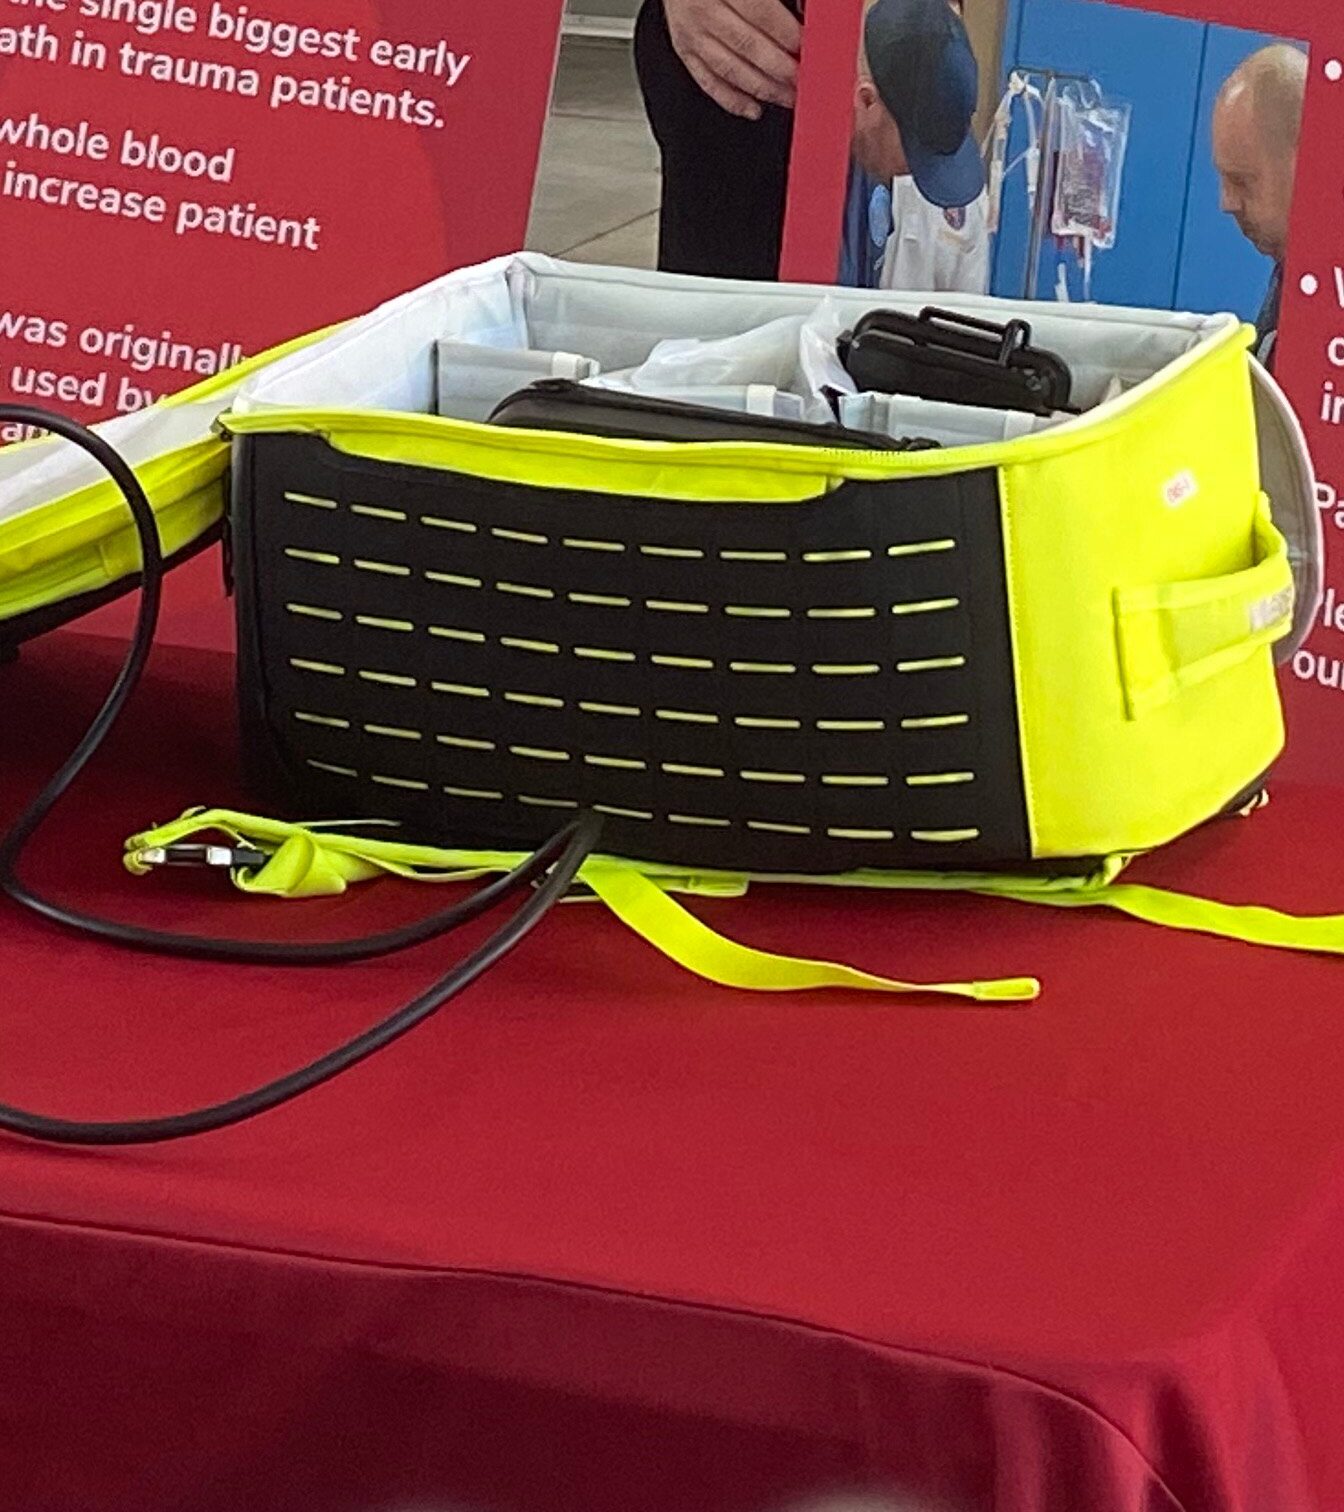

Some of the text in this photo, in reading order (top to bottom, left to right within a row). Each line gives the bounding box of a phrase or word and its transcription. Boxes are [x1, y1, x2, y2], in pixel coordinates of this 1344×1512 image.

[209, 2, 360, 60] biggest
[371, 41, 470, 85] early
[72, 31, 105, 68] in
[120, 43, 258, 95] trauma
[271, 76, 443, 127] patients.
[121, 130, 234, 181] blood
[4, 161, 165, 221] increase
[177, 203, 320, 250] patient
[80, 324, 248, 375] originall
[12, 367, 106, 405] used
